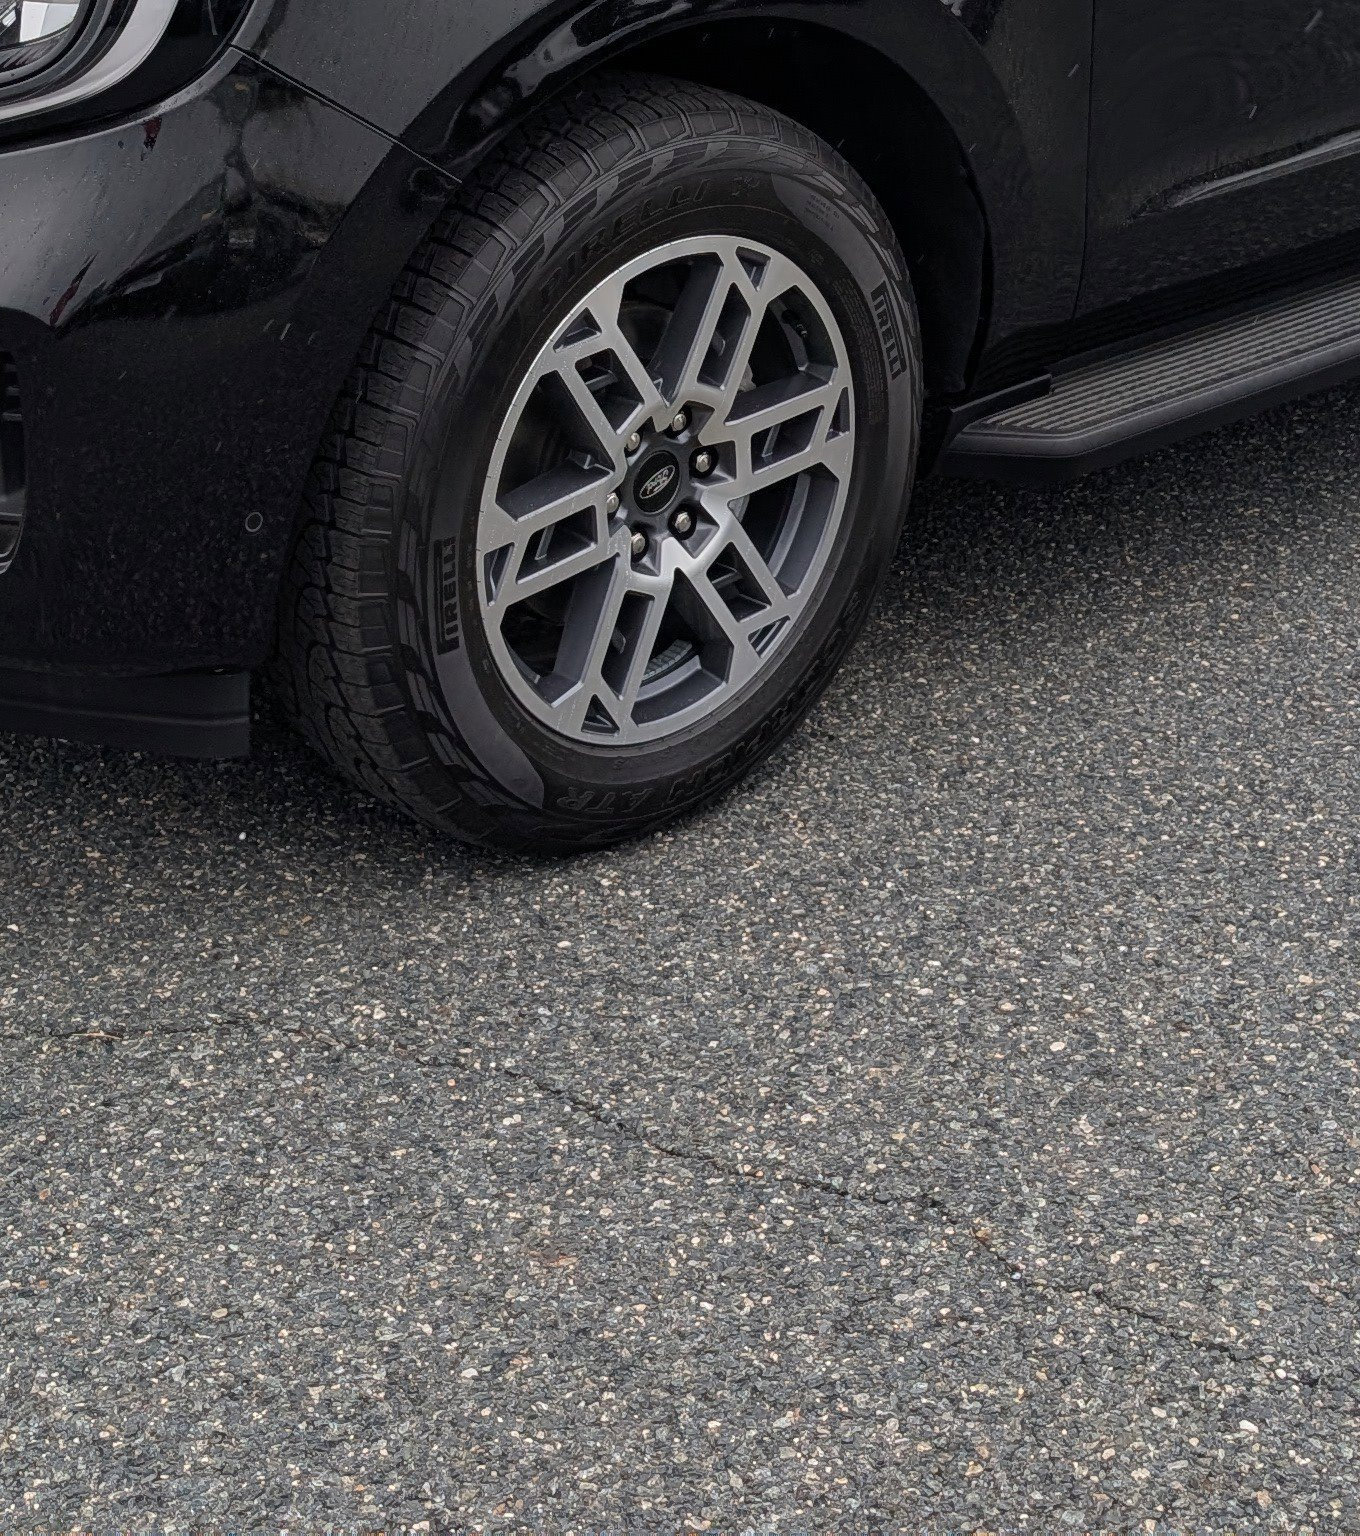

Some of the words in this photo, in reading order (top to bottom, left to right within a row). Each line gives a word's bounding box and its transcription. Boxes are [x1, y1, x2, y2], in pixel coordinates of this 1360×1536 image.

[870, 280, 907, 380] PIRELLI
[431, 536, 460, 654] PIRELLI
[555, 785, 653, 812] ATR
